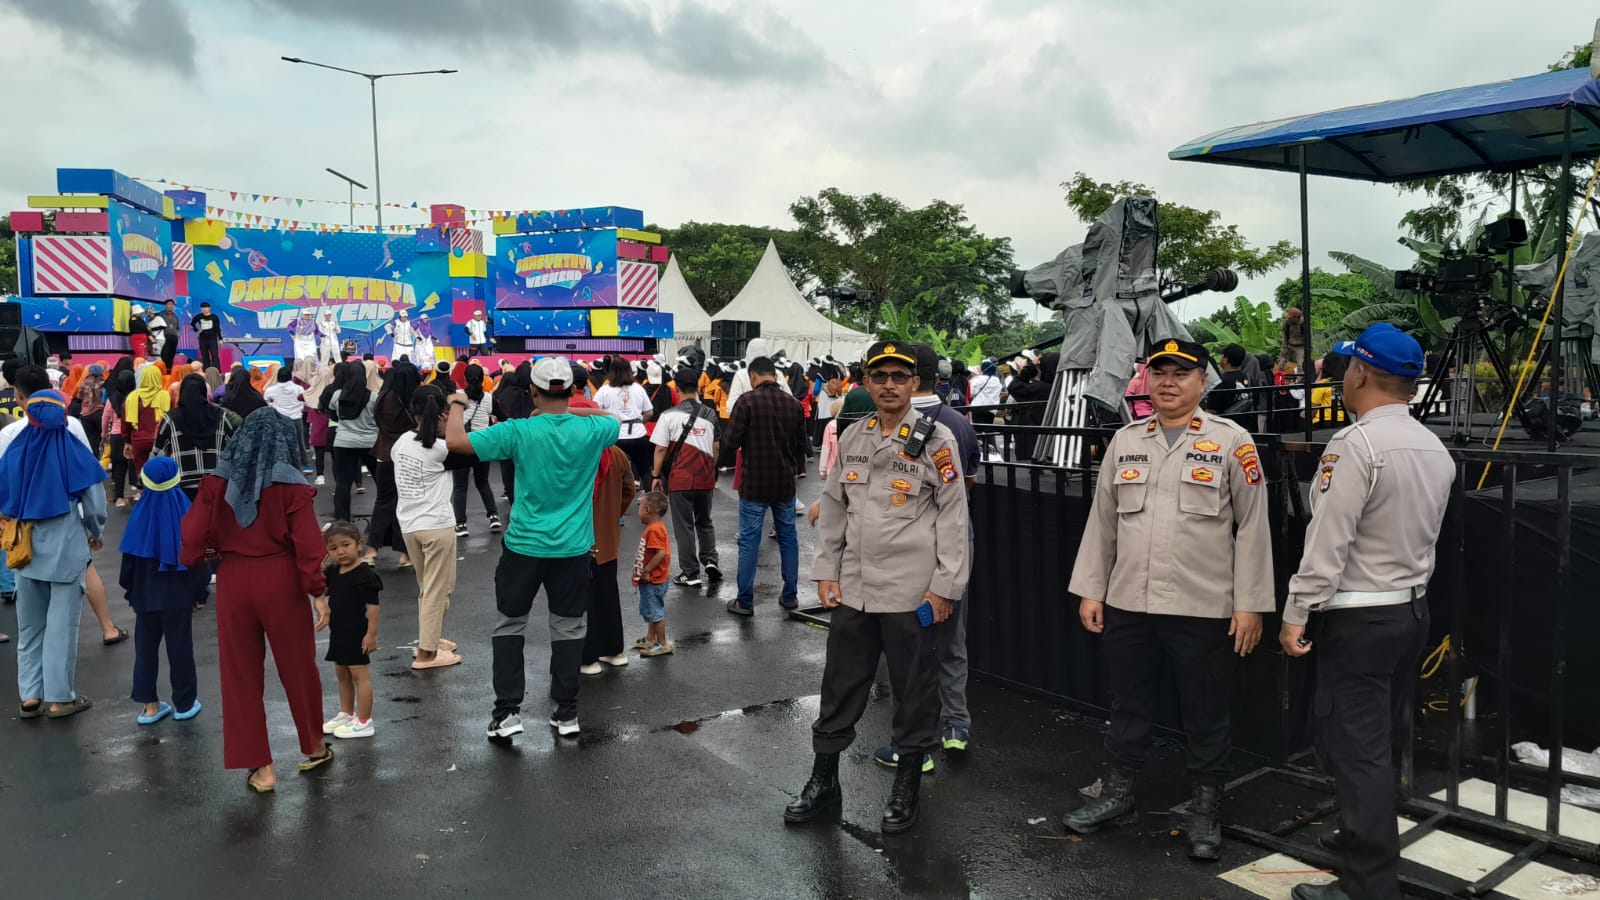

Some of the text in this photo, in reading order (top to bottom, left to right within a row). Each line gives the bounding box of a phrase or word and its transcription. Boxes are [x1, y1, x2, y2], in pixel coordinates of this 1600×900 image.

[229, 275, 416, 304] DAHSYATNYA
[1186, 452, 1223, 464] POLRI
[893, 461, 919, 474] POLRI
